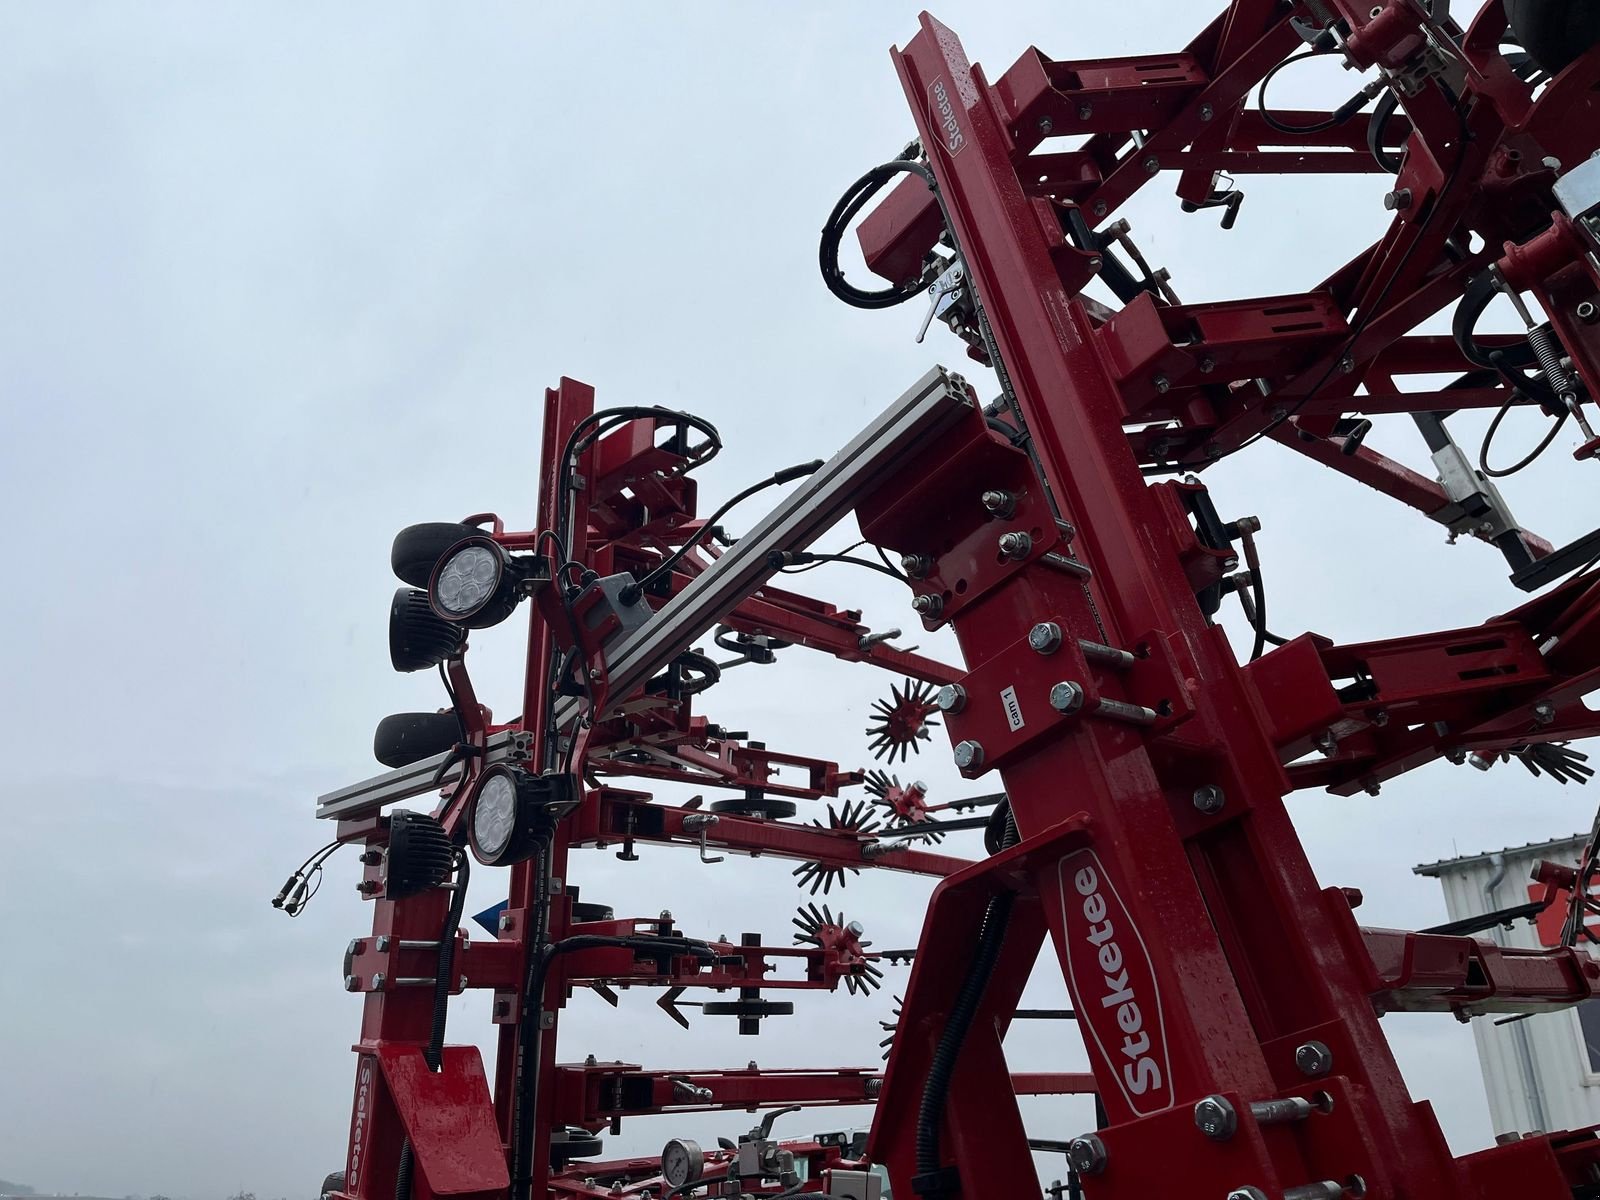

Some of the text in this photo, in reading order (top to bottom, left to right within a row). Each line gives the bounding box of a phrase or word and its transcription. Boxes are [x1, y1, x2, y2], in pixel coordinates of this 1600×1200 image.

[934, 81, 963, 150] Steketee
[1008, 701, 1020, 726] cam
[1075, 865, 1162, 1095] Steketee
[350, 1067, 370, 1186] Steketee
